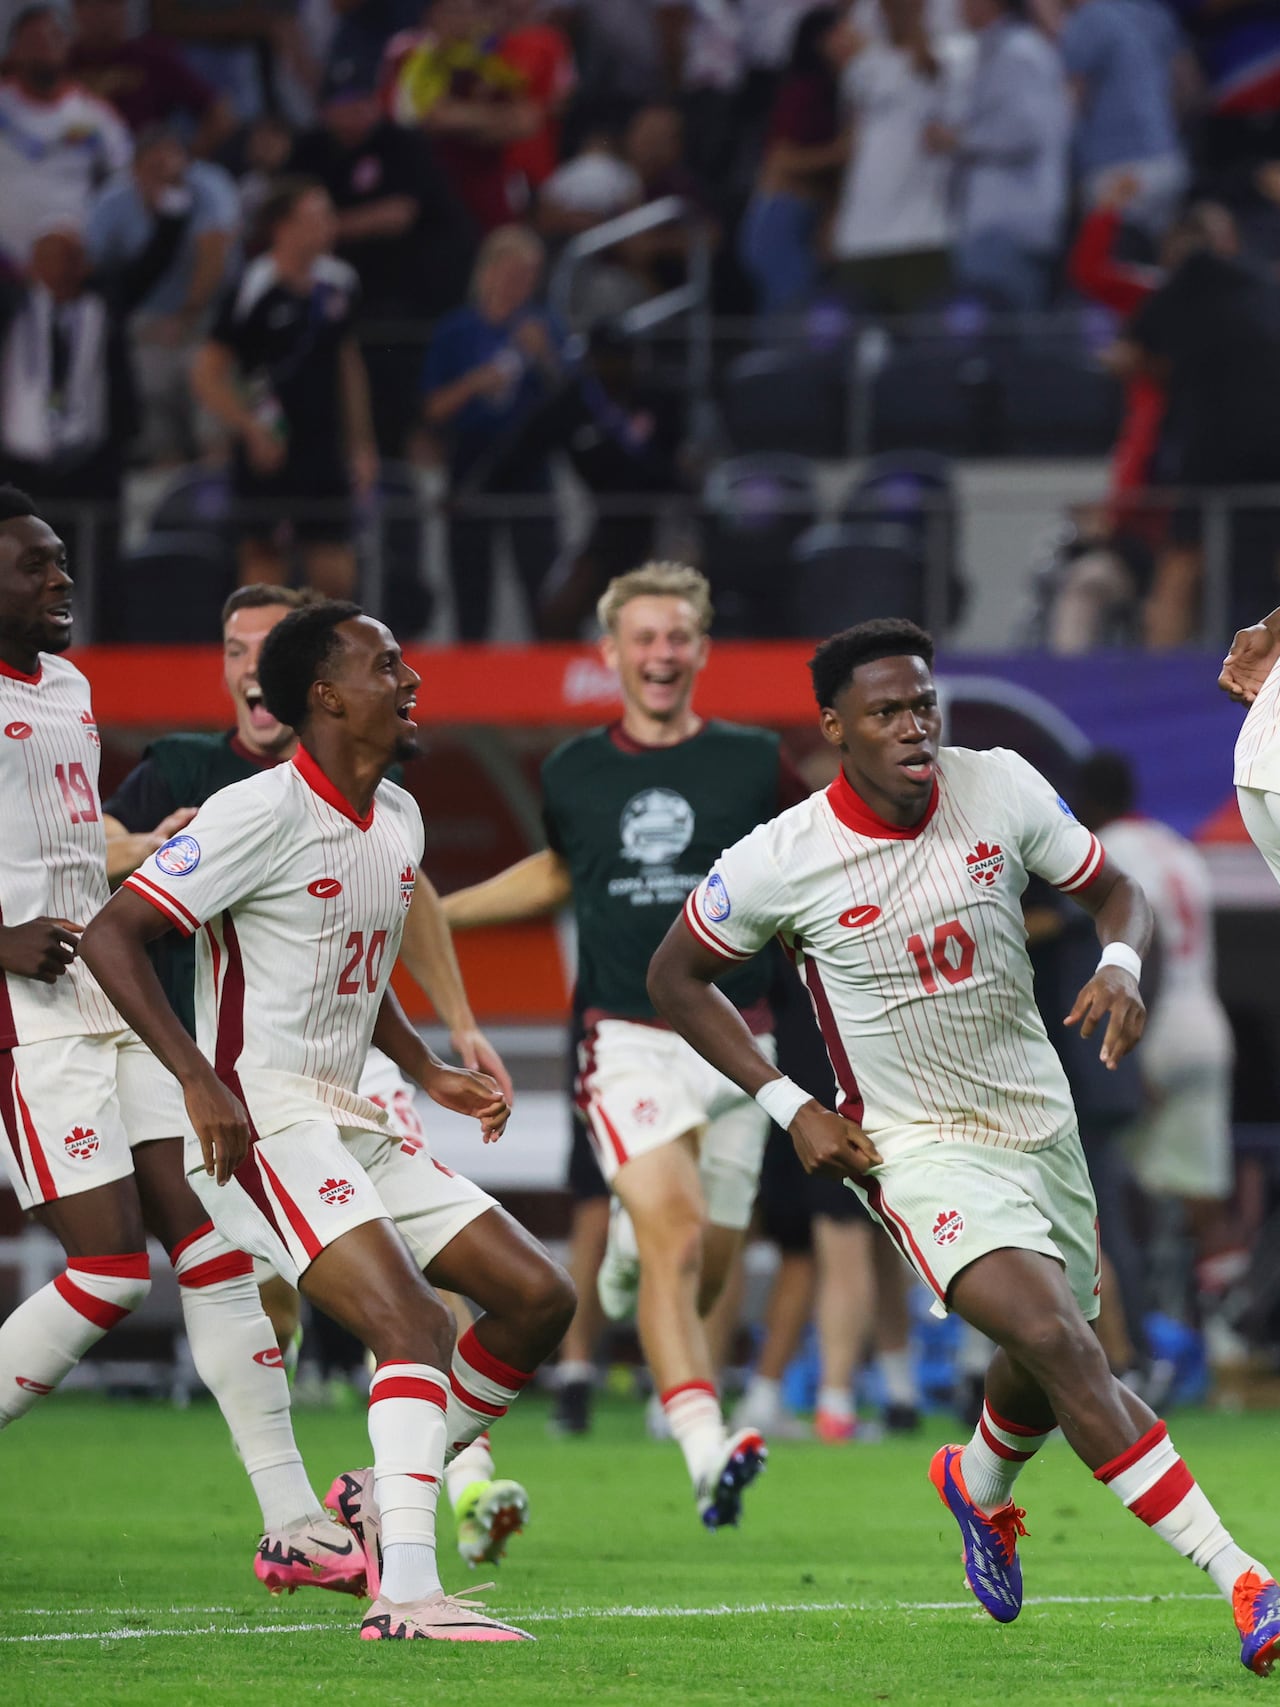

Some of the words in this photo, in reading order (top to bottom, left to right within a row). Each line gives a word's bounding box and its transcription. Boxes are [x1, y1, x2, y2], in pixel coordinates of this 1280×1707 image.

[55, 762, 98, 824] 19
[967, 854, 1005, 874] CANADA
[337, 930, 388, 995] 20
[907, 919, 976, 994] 10
[64, 1135, 99, 1151] CANADA
[320, 1184, 353, 1200] CANADA
[933, 1216, 962, 1241] CANADA
